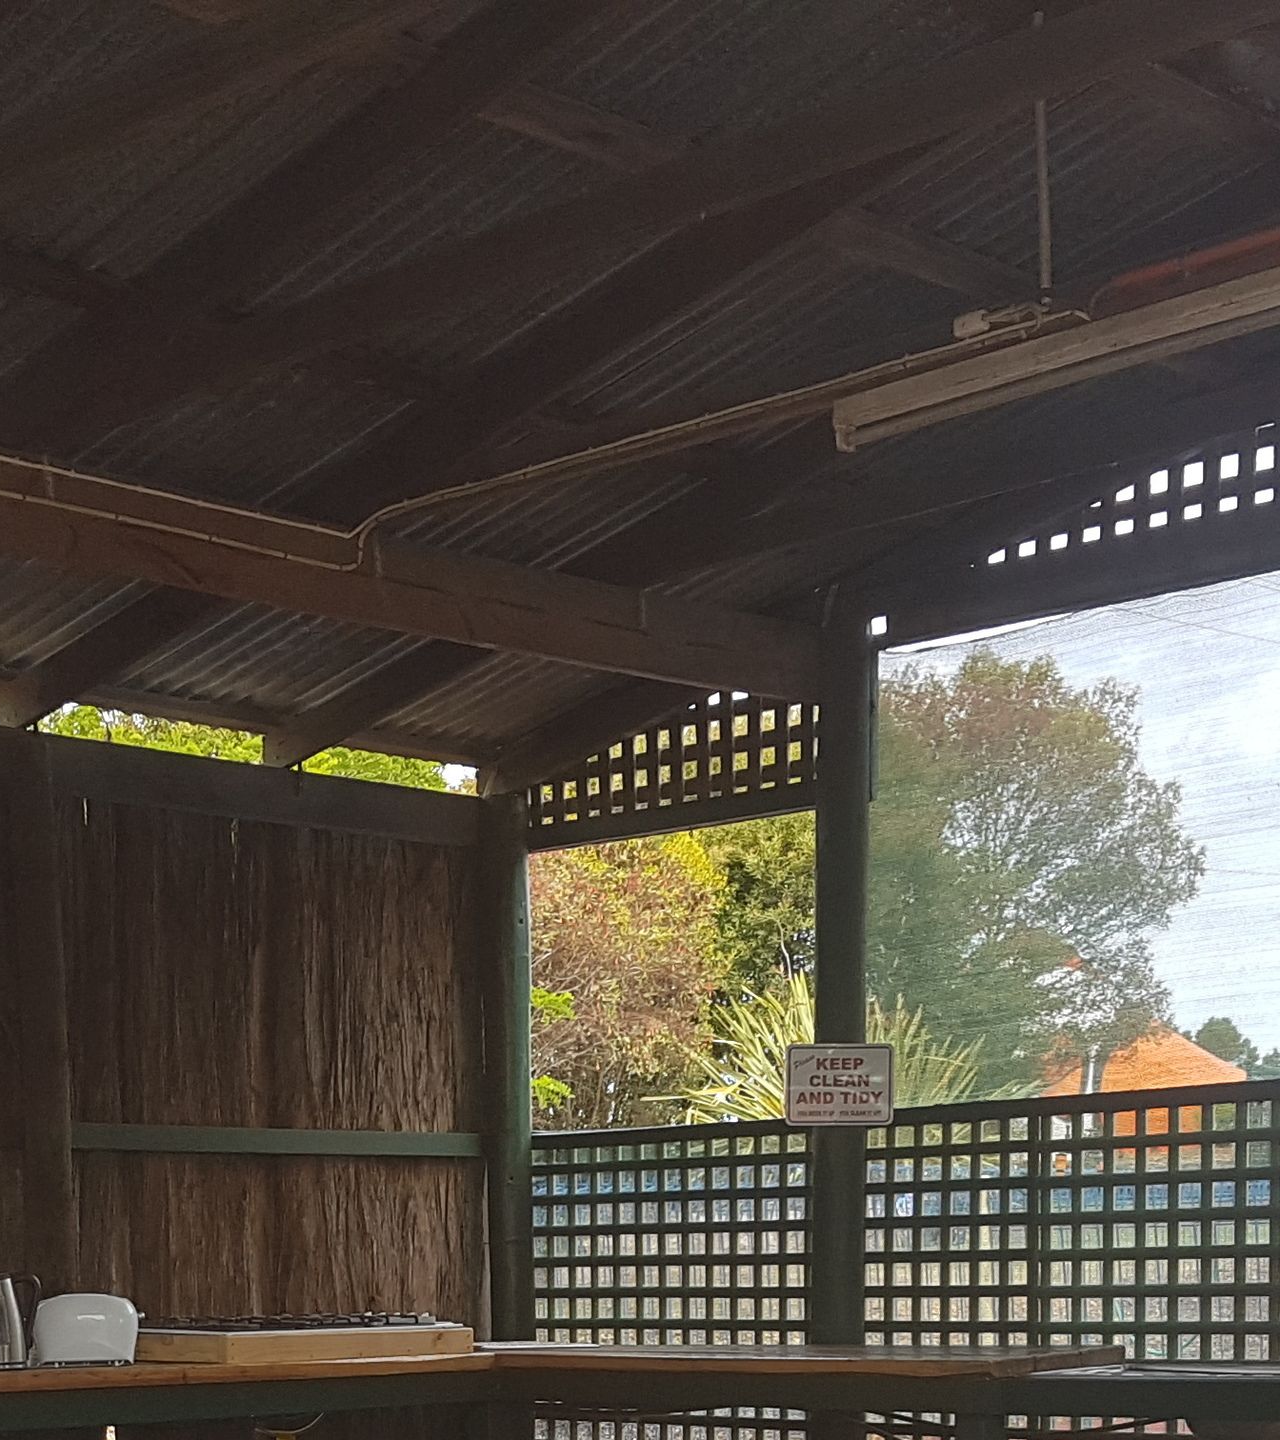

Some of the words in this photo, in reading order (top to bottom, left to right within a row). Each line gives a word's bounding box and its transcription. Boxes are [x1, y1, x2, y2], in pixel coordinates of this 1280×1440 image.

[815, 1058, 864, 1071] KEEP
[809, 1075, 870, 1088] CLEAN
[796, 1091, 835, 1105] AND
[839, 1091, 884, 1105] TIDY
